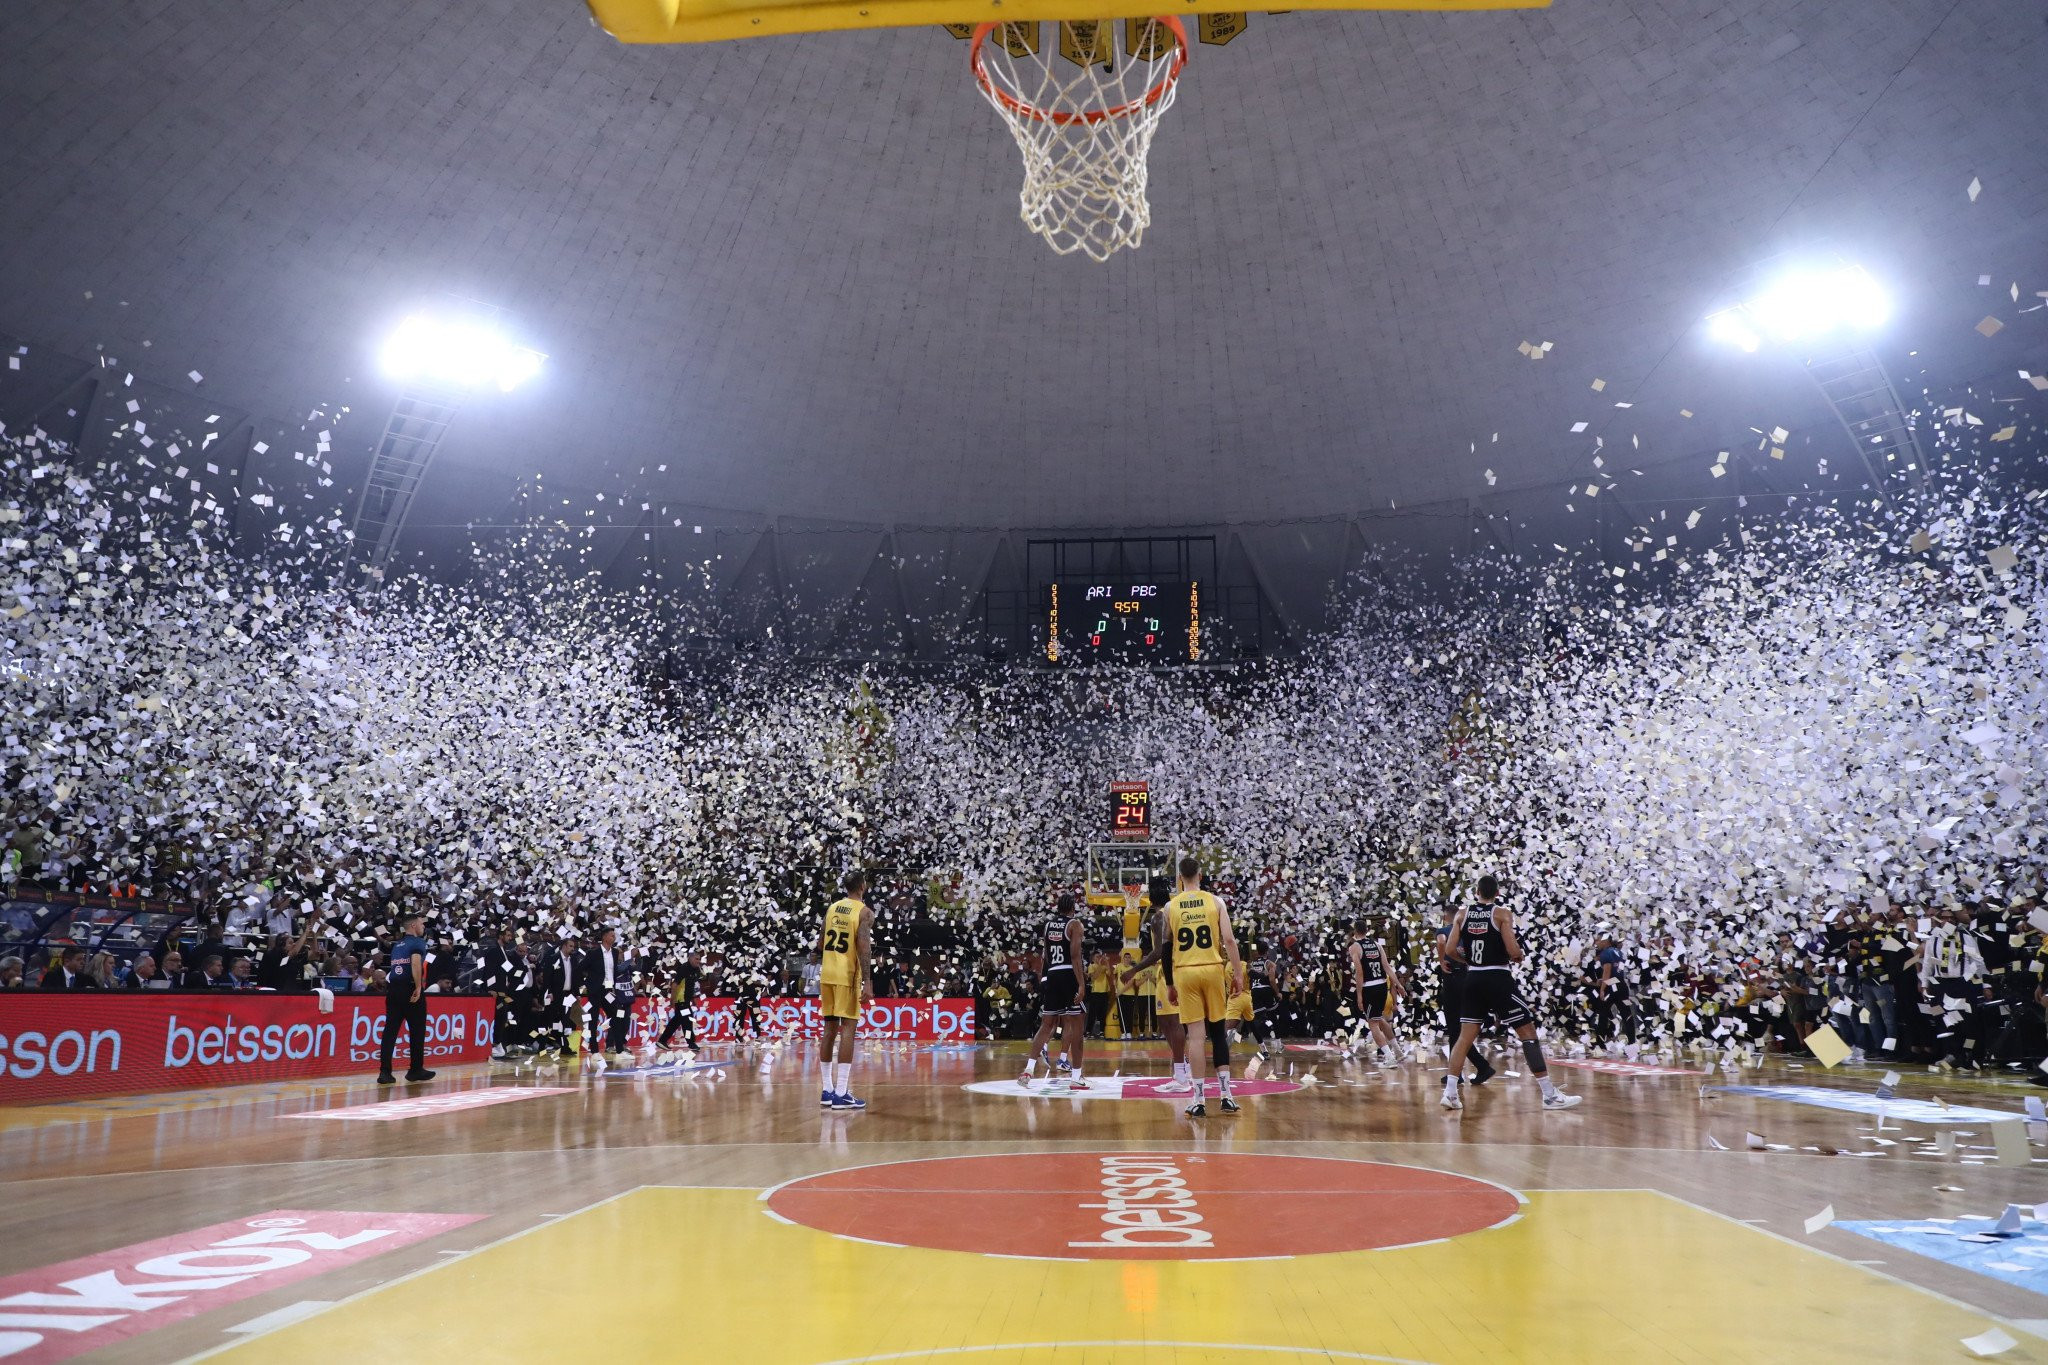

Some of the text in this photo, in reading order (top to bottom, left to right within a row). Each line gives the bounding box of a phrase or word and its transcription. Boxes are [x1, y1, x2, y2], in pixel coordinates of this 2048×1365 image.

[1211, 25, 1236, 39] 1989
[1087, 585, 1157, 597] ARI PBC
[1114, 602, 1139, 612] 9:59
[1098, 620, 1106, 632] 0
[1150, 619, 1159, 631] 0
[1092, 634, 1155, 646] 0 0
[1121, 792, 1148, 805] 9:59
[1117, 806, 1144, 825] 24
[1467, 910, 1491, 920] FERADIS
[824, 929, 850, 954] 25
[1177, 924, 1213, 952] 98
[1050, 945, 1065, 965] 26
[1470, 939, 1485, 965] 18
[748, 1000, 917, 1028] beton
[350, 1006, 466, 1046] beson
[164, 1014, 336, 1068] betsson
[0, 1029, 122, 1079] son
[1067, 1156, 1215, 1248] betsson
